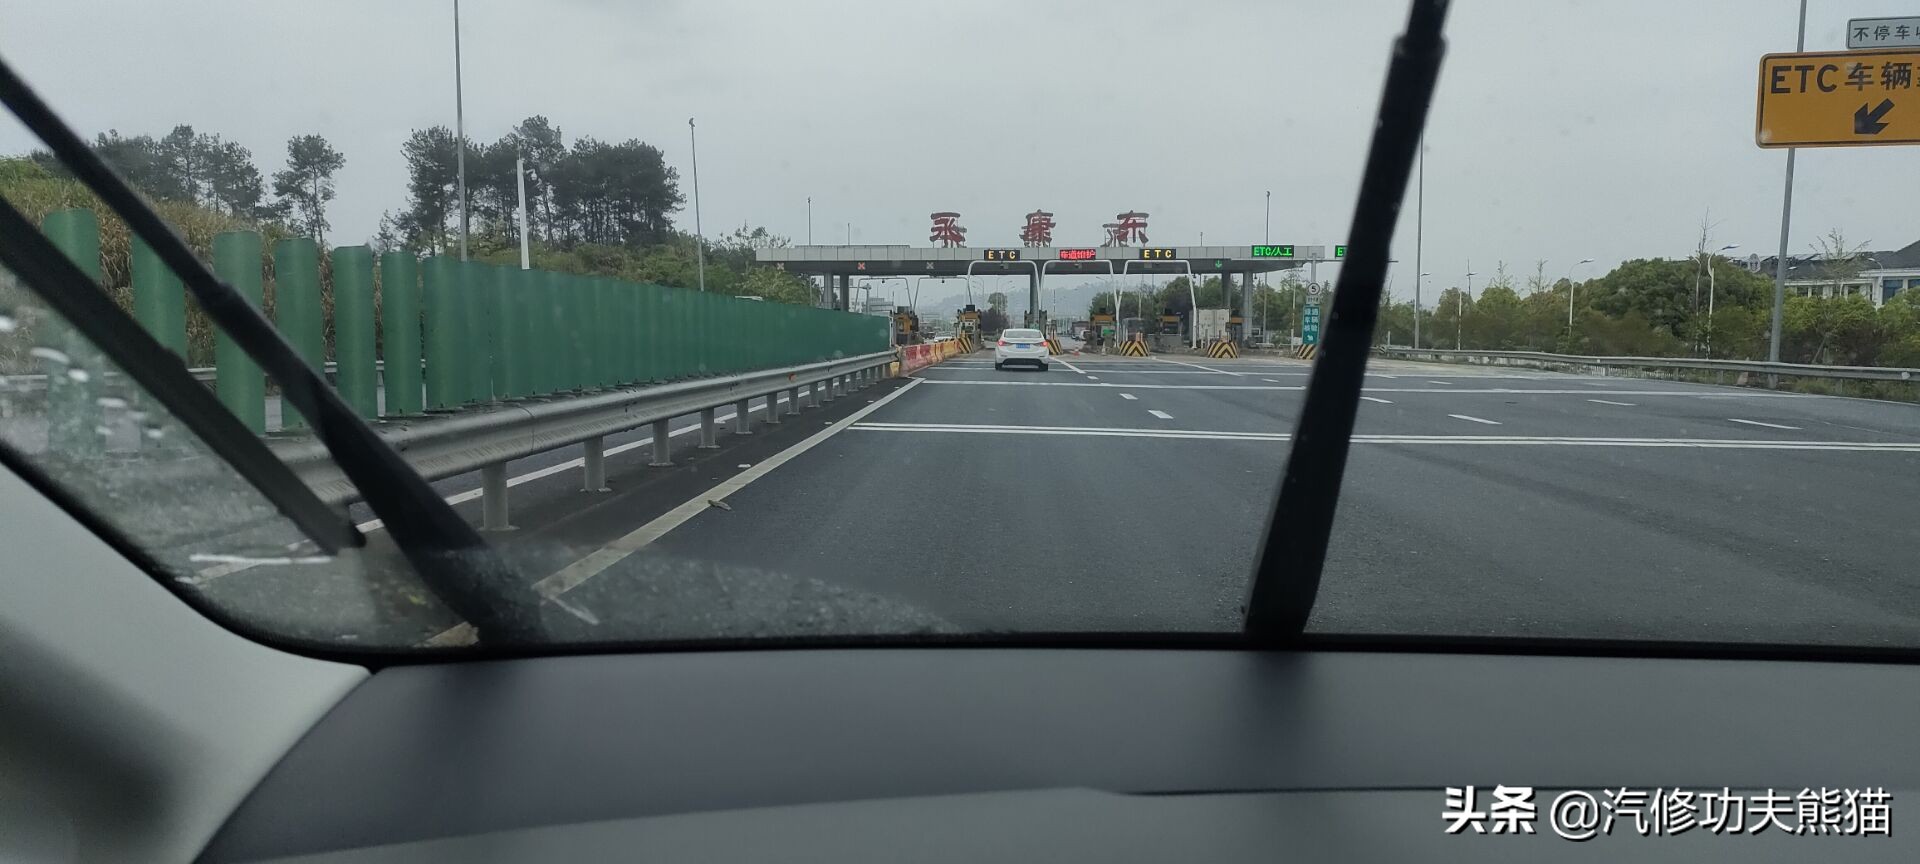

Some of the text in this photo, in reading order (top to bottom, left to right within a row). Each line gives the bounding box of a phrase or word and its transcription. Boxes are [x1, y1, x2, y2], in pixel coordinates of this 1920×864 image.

[1770, 61, 1920, 94] ETC车辆
[988, 250, 1016, 259] ETC
[1143, 249, 1172, 258] ETC
[1253, 246, 1292, 256] ETC/人工
